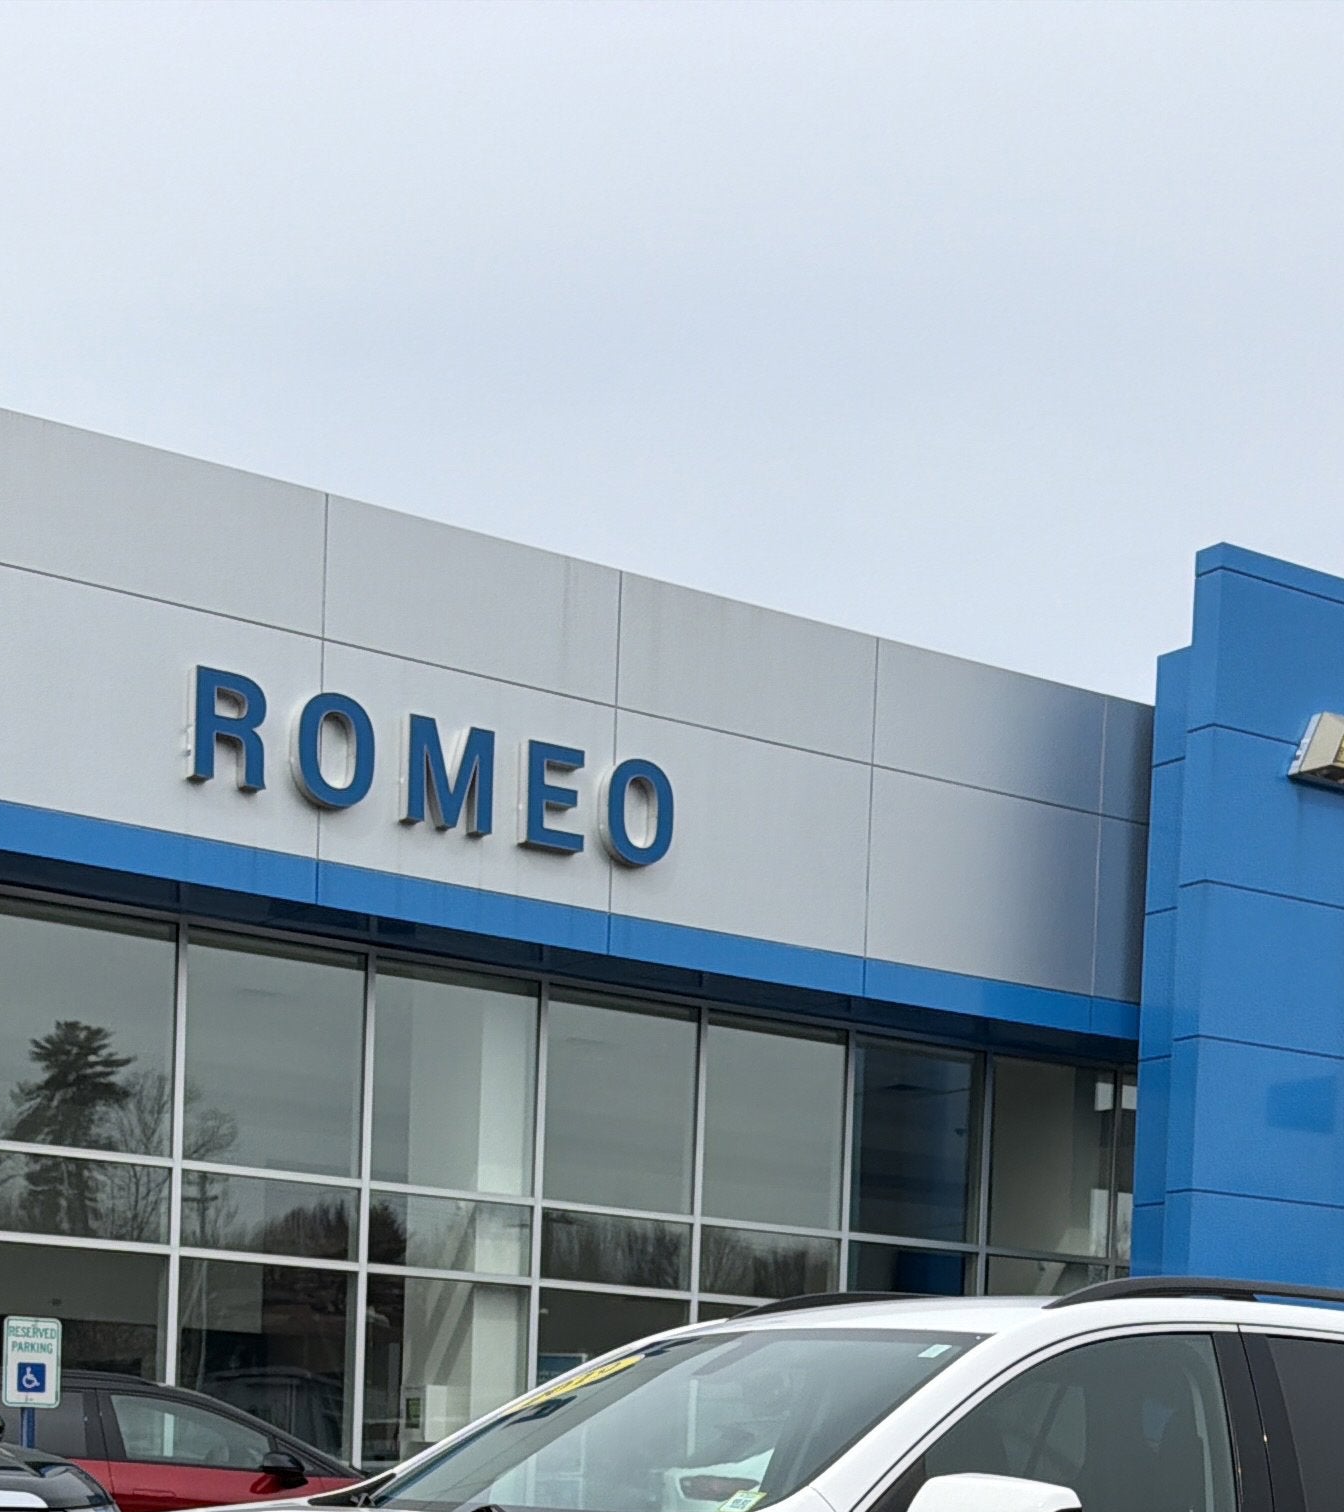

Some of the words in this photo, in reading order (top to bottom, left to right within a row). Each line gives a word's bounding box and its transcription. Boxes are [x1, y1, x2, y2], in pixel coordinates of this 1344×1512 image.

[187, 664, 675, 868] ROMEO
[8, 1325, 57, 1340] RESERVED
[11, 1340, 54, 1355] PARKING
